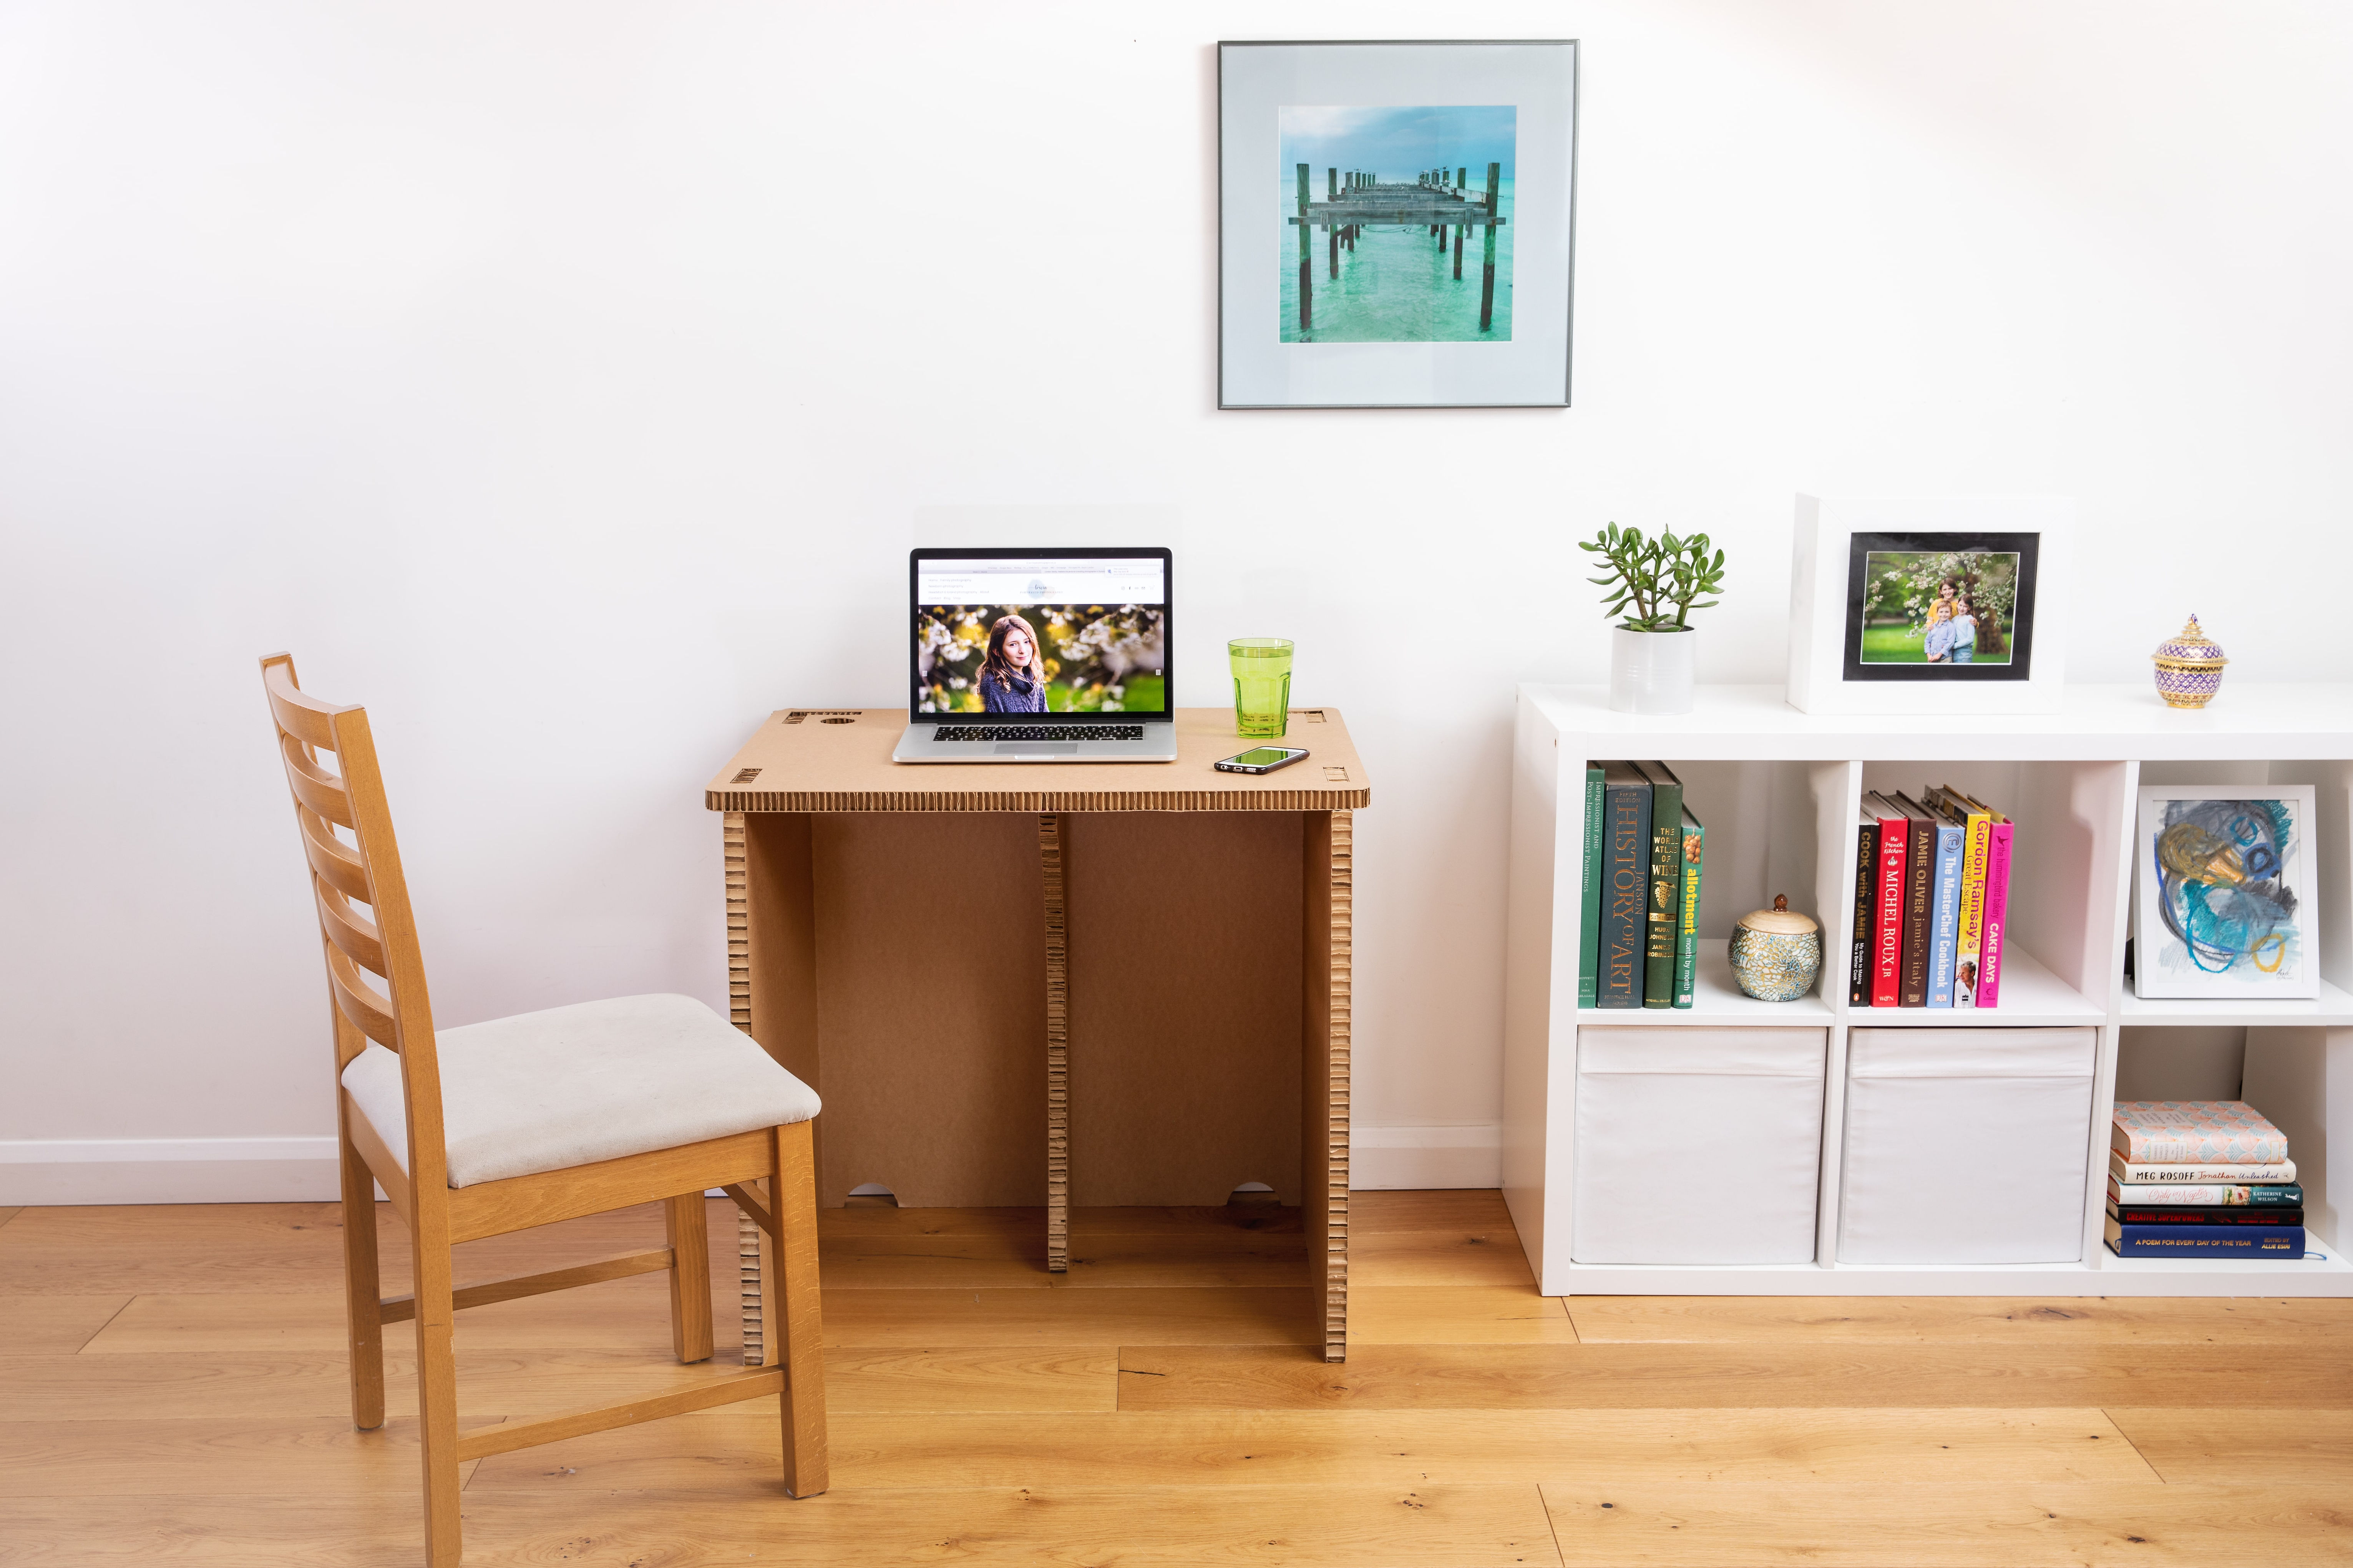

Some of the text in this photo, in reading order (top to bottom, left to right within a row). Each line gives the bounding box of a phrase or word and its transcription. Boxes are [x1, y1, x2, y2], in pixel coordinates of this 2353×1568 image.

[1585, 782, 1593, 854] POST-IMPRESSIONIST
[1594, 782, 1602, 832] IMPRESSIONIST
[1652, 865, 1678, 876] WINE
[1917, 831, 1929, 867] JAMIE
[1610, 805, 1638, 994] HISTORY OF ART
[1634, 871, 1645, 915] JANSON
[1855, 832, 1871, 939] COOK with JAMIE
[1914, 870, 1926, 913] OLIVER
[1961, 855, 1974, 914] Great Escape
[1966, 820, 1988, 949] Gordon Ramsay's
[1993, 859, 2005, 897] hummingbird
[1684, 869, 1698, 935] allotment
[1936, 857, 1956, 988] The MasterChef Cookbook
[1990, 898, 2001, 919] bakery
[1882, 870, 1898, 978] MICHEL ROUX JR
[1912, 916, 1925, 957] jamie's
[1683, 960, 1691, 969] by
[1910, 961, 1922, 986] italy
[1985, 923, 1999, 983] CAKE DAYS
[2136, 1170, 2278, 1180] MEG ROSOFF Jonathan Unleashed
[2146, 1188, 2171, 1204] Only
[2175, 1187, 2214, 1204] Naples
[2127, 1213, 2204, 1222] CREATIVE SUPERPOWERS
